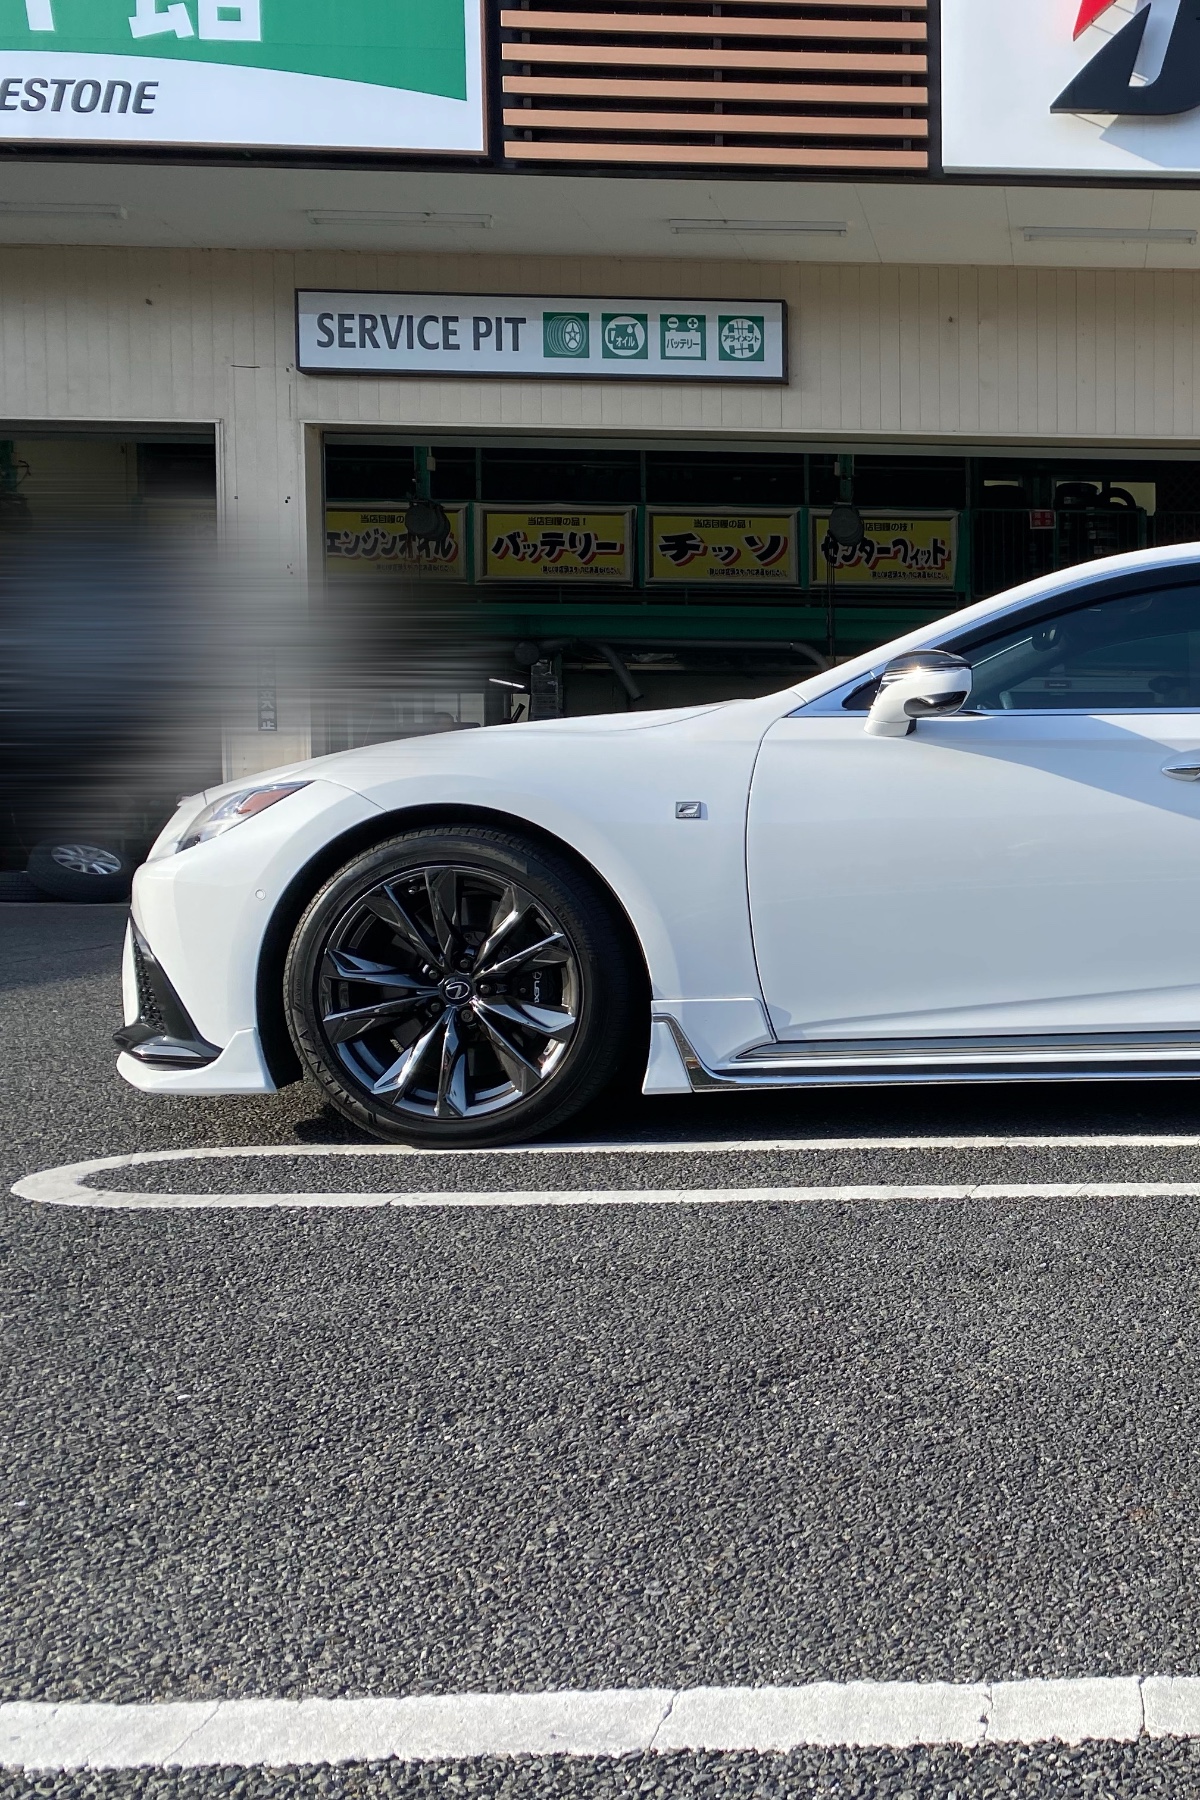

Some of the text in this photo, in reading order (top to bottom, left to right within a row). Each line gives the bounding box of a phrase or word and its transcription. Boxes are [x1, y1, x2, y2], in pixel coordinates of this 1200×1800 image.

[316, 312, 527, 352] SERVICE PIT
[615, 336, 635, 348] オイル
[666, 338, 701, 349] バッテリー
[490, 530, 622, 564] バッテリー
[657, 531, 787, 566] チッソ
[299, 1028, 357, 1106] ALENZA
